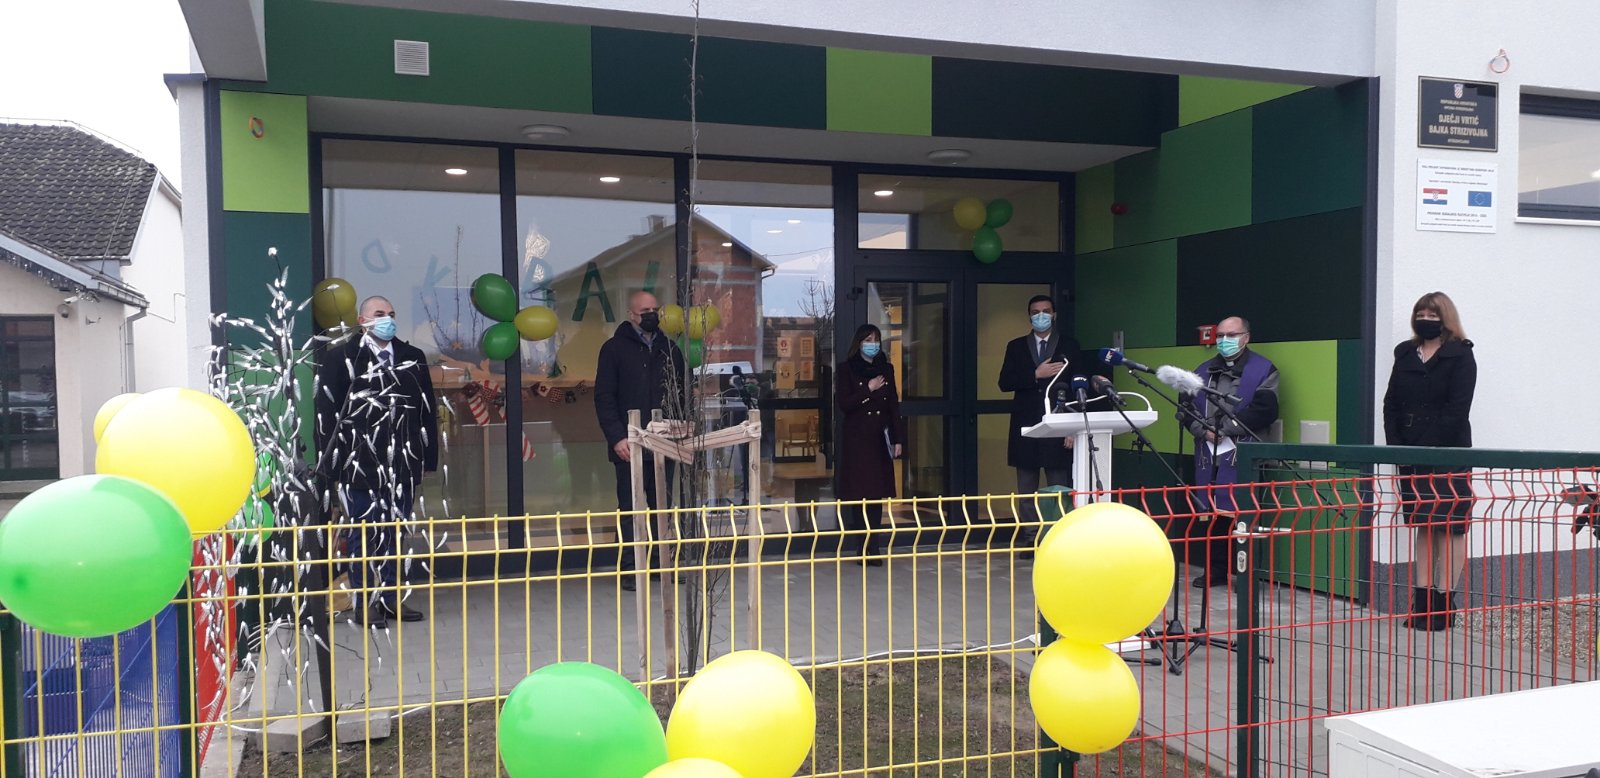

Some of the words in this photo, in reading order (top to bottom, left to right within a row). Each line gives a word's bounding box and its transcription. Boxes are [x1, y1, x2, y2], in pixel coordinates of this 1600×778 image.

[1439, 113, 1460, 123] DJEČJI
[1461, 115, 1479, 125] VRTIĆ
[1429, 125, 1449, 134] BAJKA
[1449, 126, 1488, 137] STRIZIVOJNA
